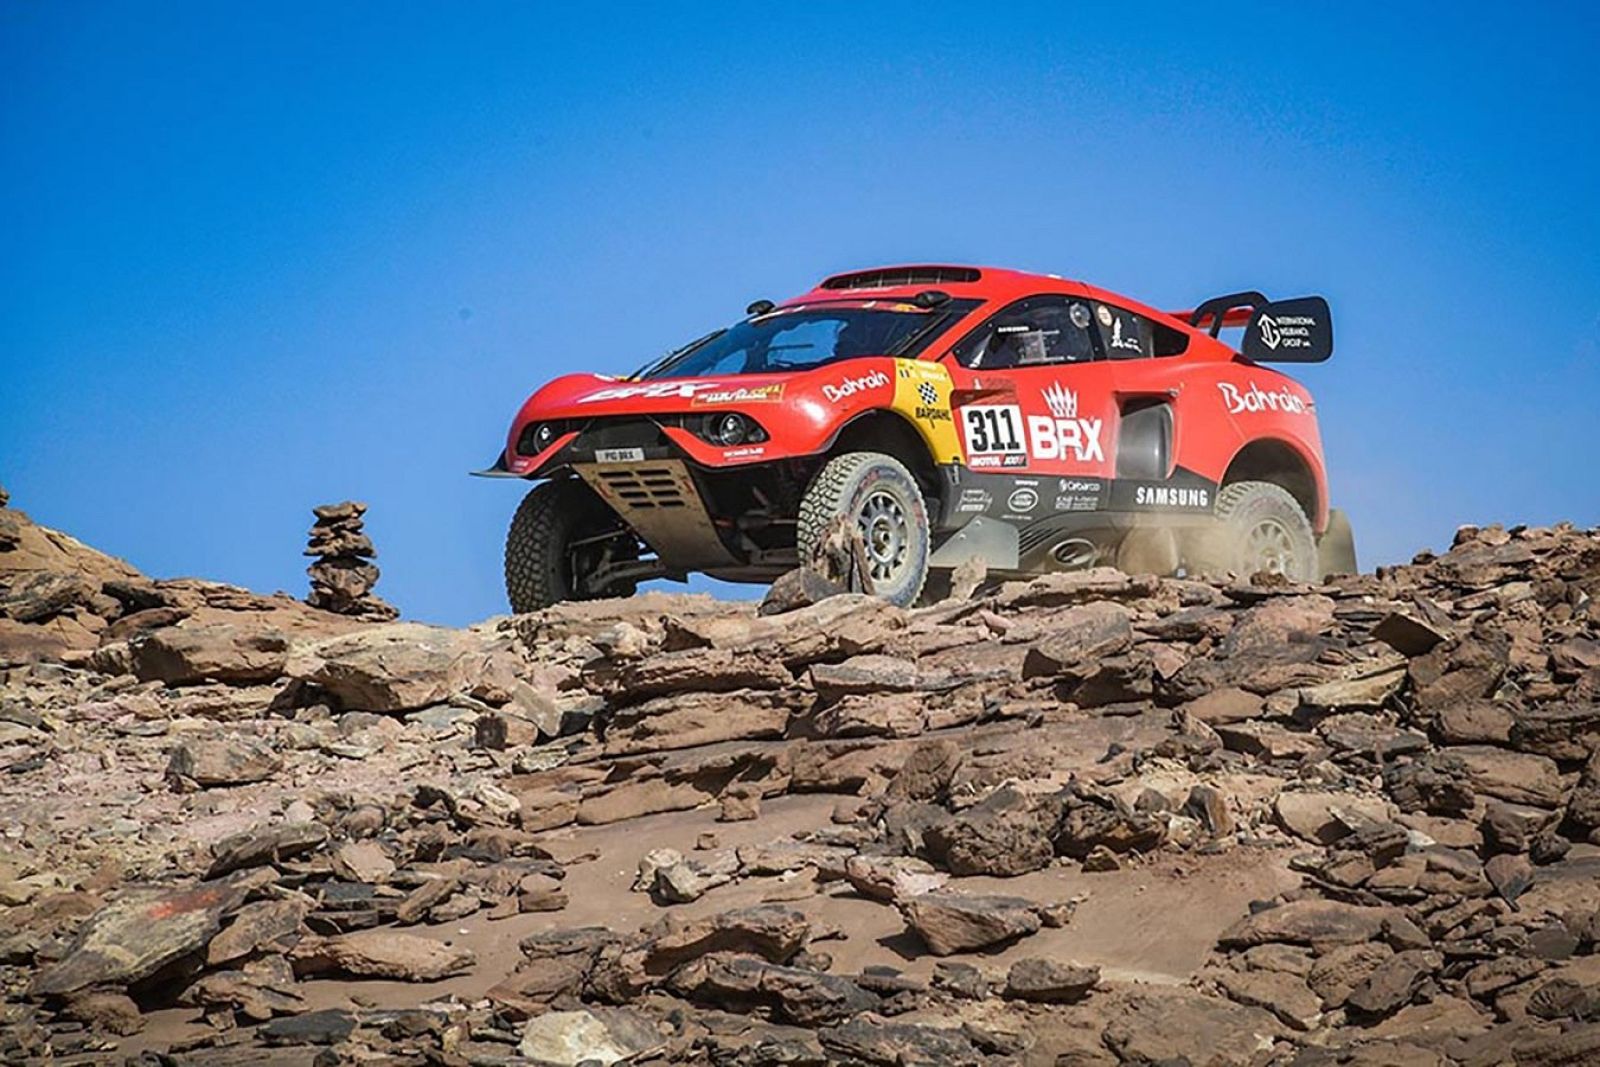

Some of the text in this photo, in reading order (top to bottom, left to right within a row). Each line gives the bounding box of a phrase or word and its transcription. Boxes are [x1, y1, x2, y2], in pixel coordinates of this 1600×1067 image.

[822, 369, 891, 403] Bahrain
[1216, 381, 1307, 414] Bahrain
[915, 406, 951, 421] BARDAHL
[967, 408, 1021, 452] 311
[1027, 415, 1105, 462] BRX
[970, 455, 1001, 467] MOTUL
[1136, 486, 1209, 507] SAMSUNG
